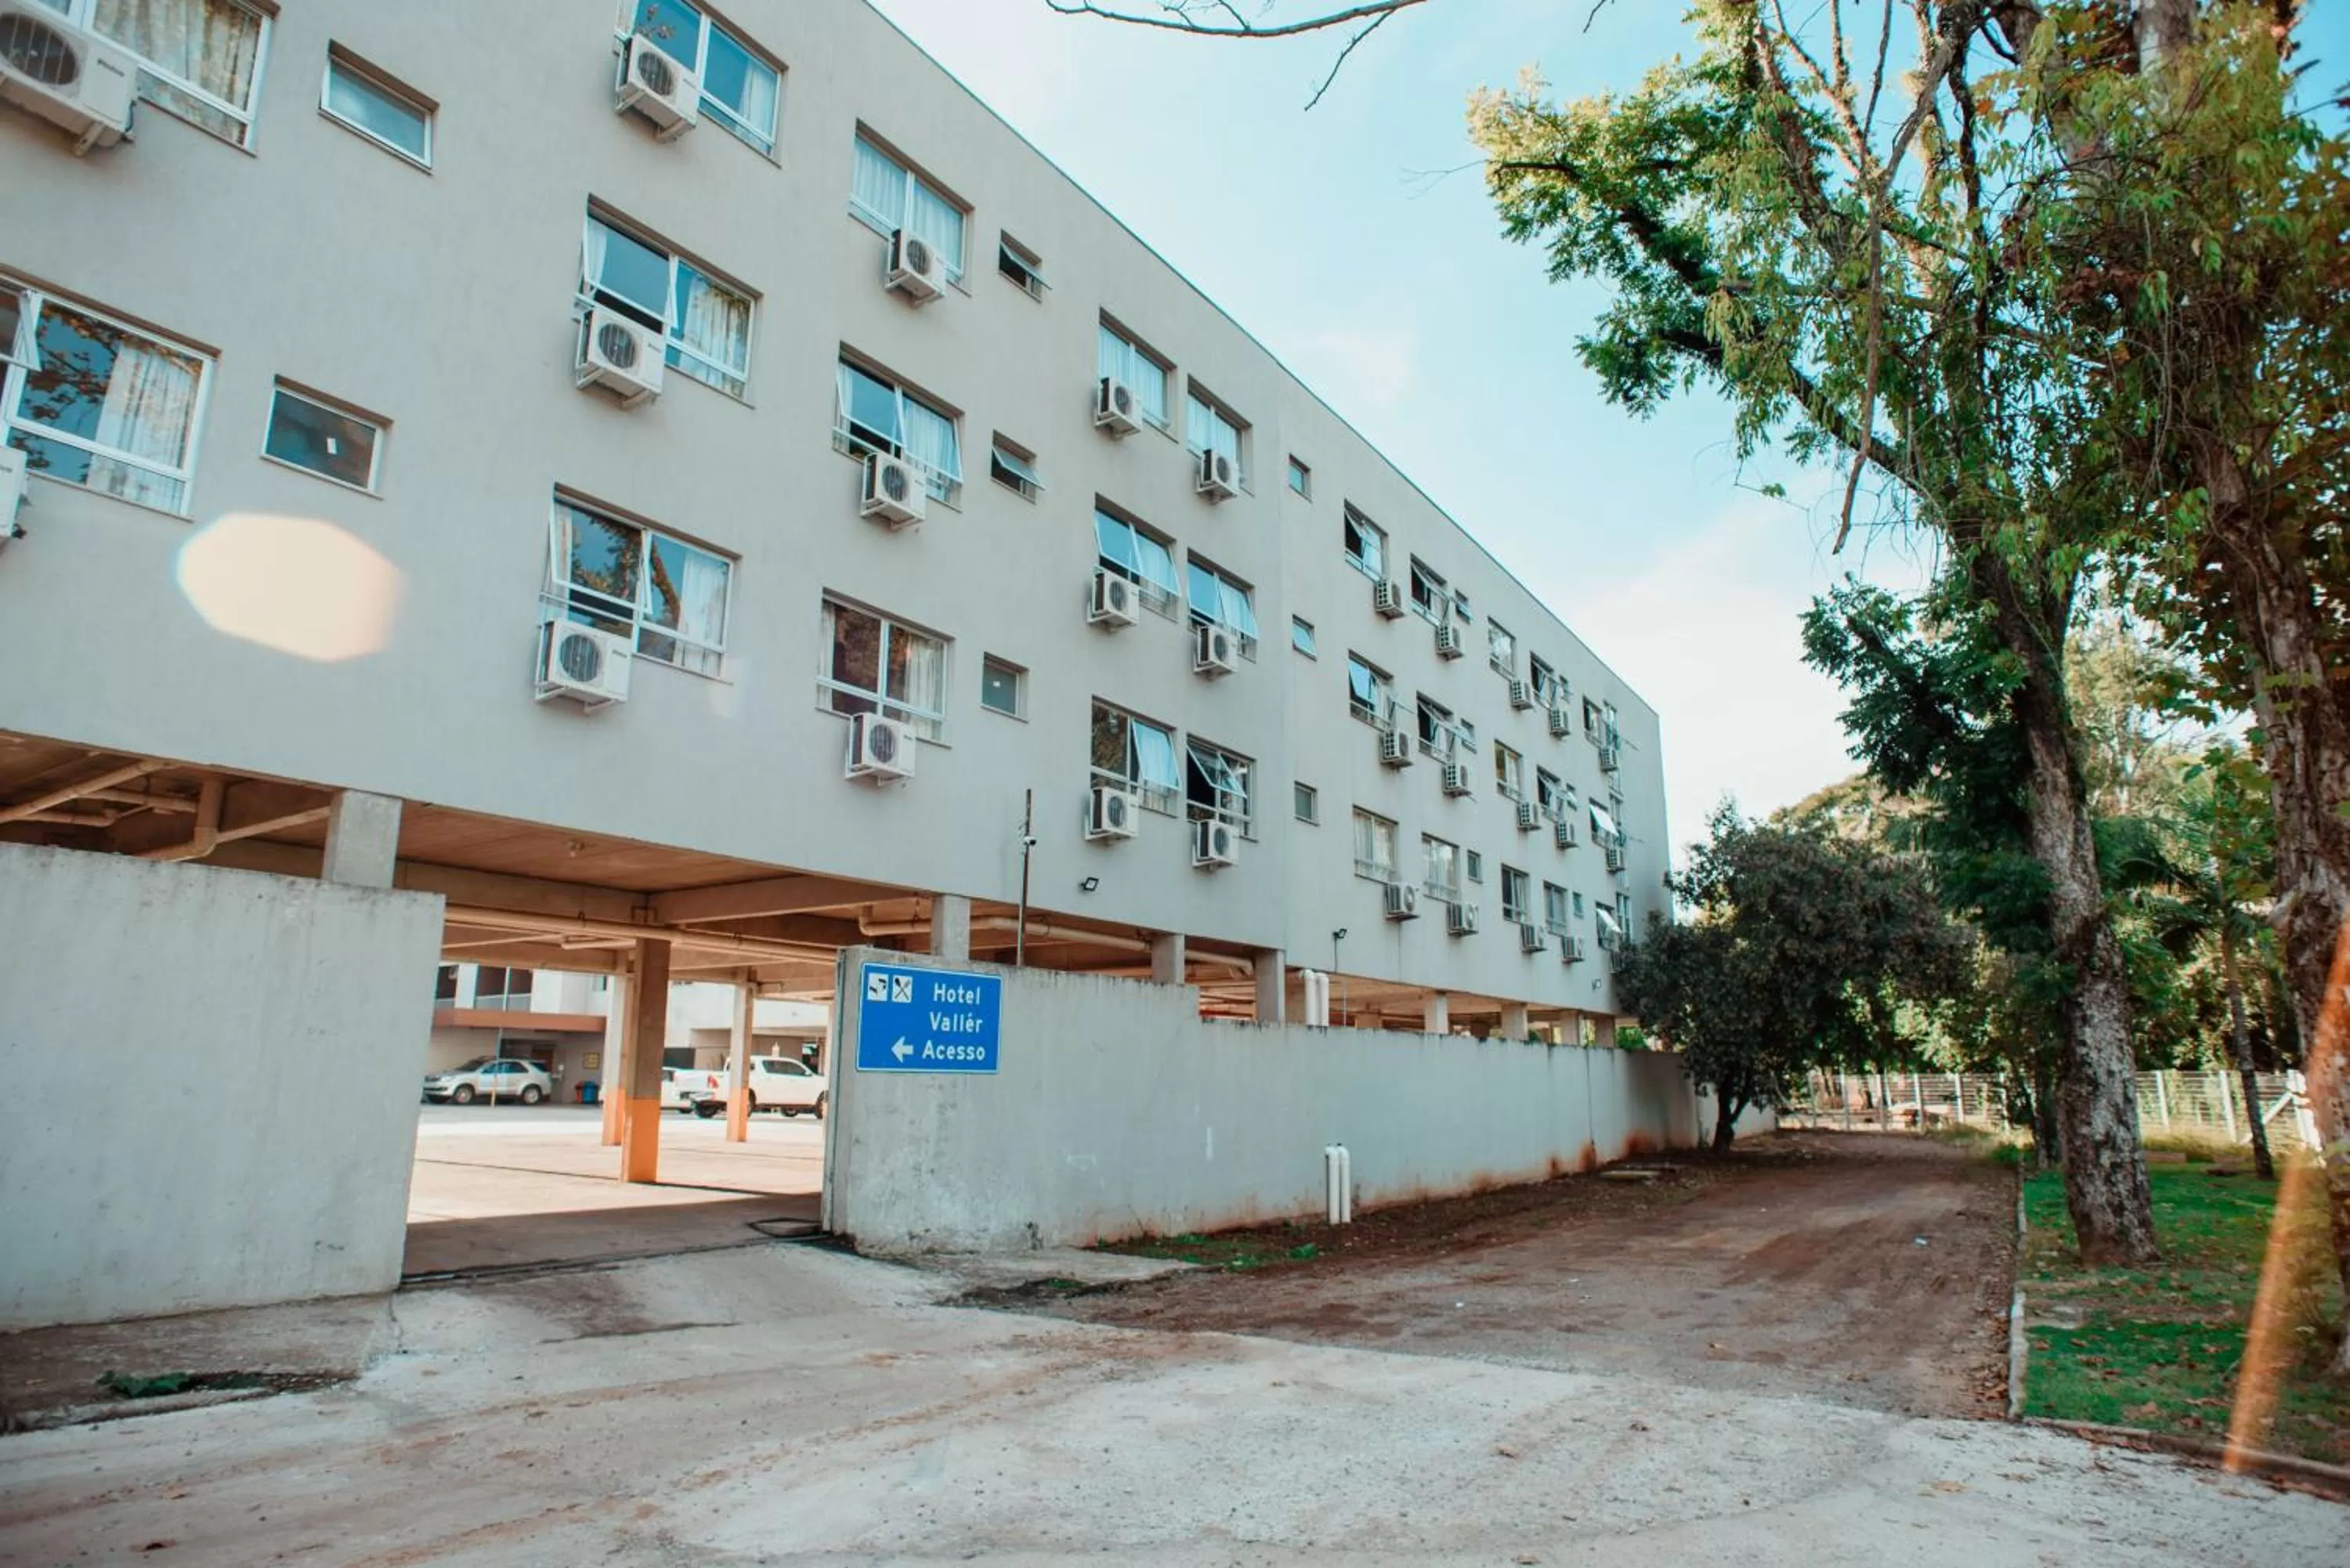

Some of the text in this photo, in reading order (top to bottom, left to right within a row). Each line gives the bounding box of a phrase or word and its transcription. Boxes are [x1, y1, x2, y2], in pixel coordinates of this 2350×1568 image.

[933, 982, 981, 1005] Hotel
[929, 1011, 983, 1033] Vallér
[922, 1039, 985, 1061] Acesso
